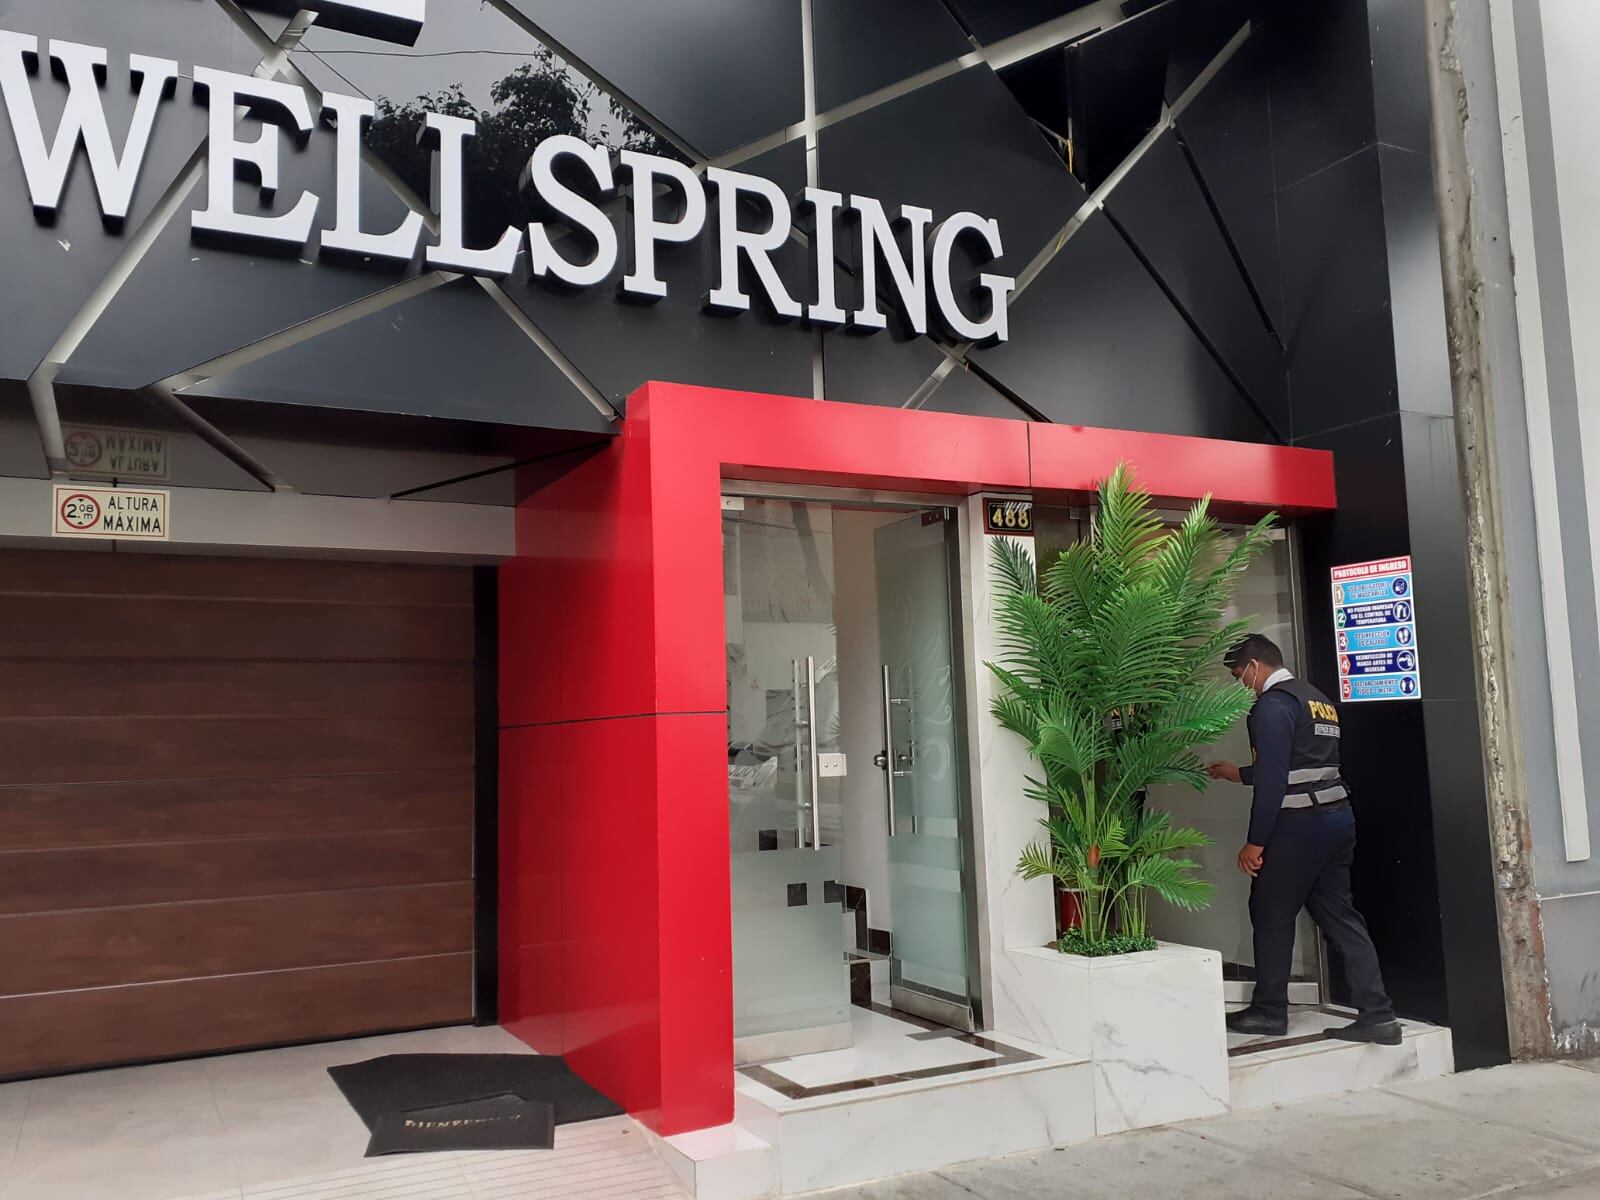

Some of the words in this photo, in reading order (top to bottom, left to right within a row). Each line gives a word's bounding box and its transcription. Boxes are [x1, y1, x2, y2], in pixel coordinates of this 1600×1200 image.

[0, 30, 1016, 343] WELLSPRING
[108, 496, 158, 511] ALTURA
[103, 512, 162, 533] MÁXIMA
[1333, 565, 1369, 579] PROTOCOLO
[1369, 564, 1378, 573] DE
[1378, 560, 1407, 572] INGRESO
[1337, 613, 1344, 623] 2
[1339, 636, 1346, 647] 3
[1343, 683, 1350, 695] 5
